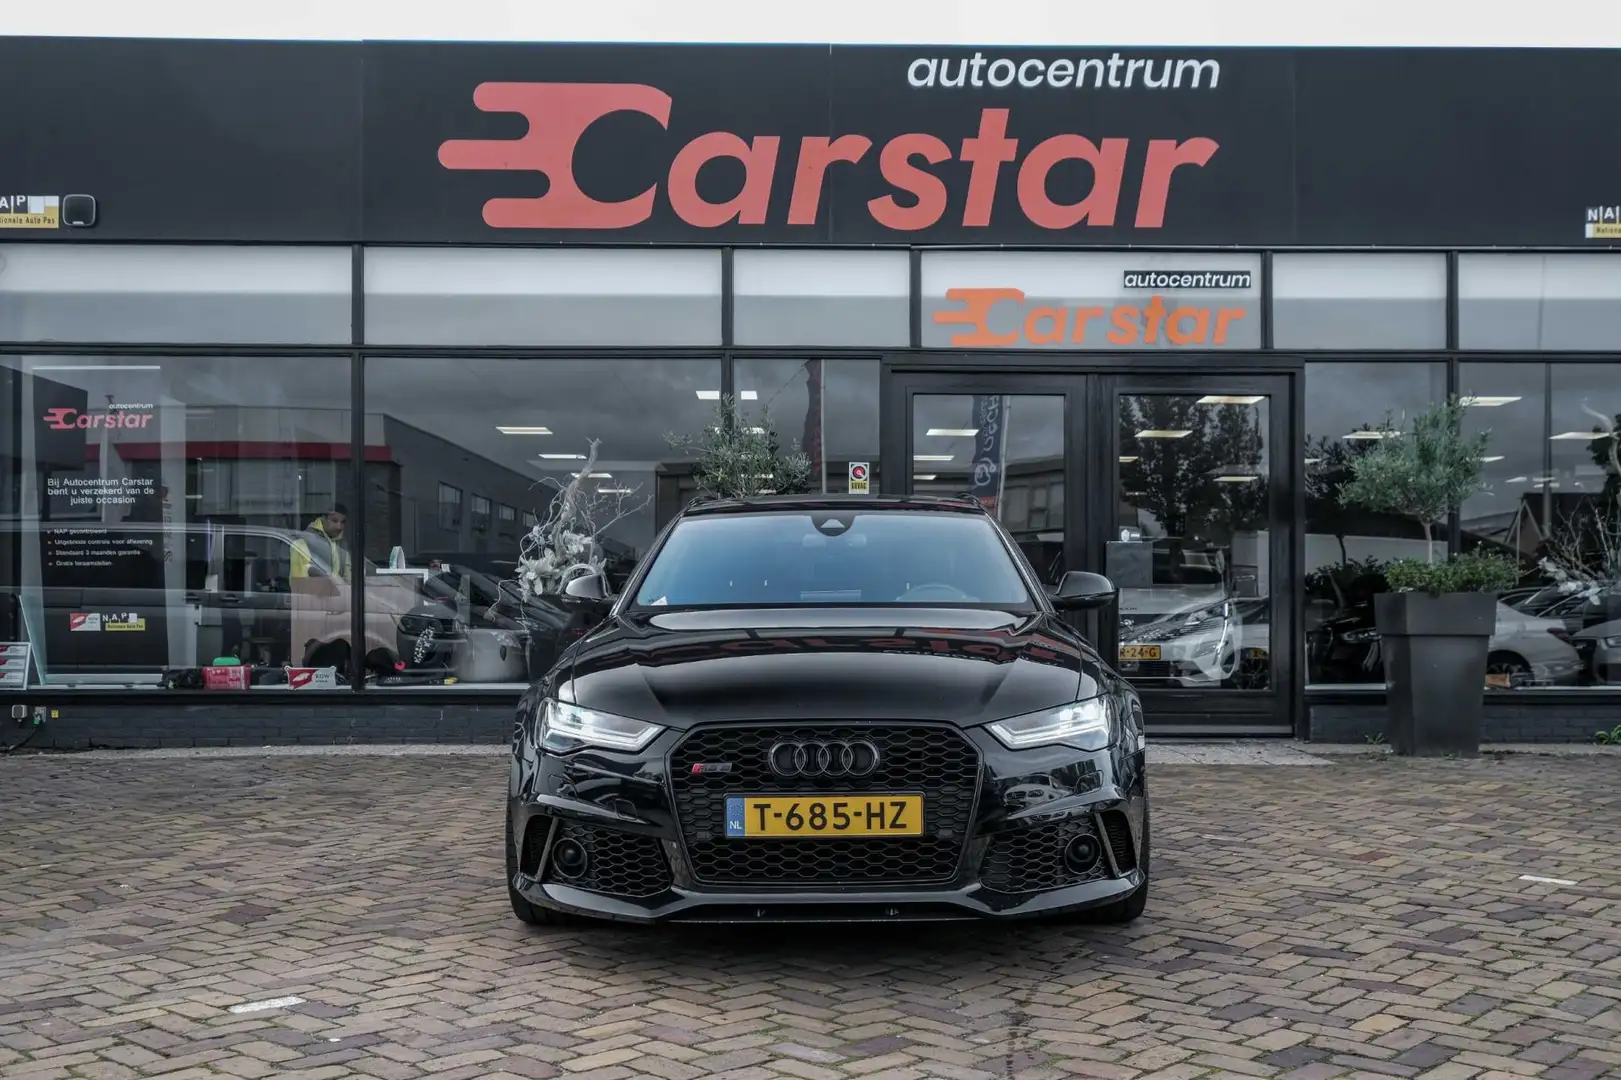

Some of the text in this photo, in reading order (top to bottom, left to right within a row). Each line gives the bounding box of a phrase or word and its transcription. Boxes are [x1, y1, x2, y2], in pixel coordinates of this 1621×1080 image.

[907, 52, 1221, 90] autocentrum
[438, 81, 1219, 231] Carstar
[26, 216, 41, 224] Auto
[43, 216, 55, 224] Pas
[1124, 271, 1251, 288] autocentrum
[932, 287, 1247, 347] Carstar
[108, 402, 154, 410] autocentrum
[43, 407, 153, 430] Carstar
[47, 477, 154, 488] Bij Autocentrum Carstar
[47, 487, 68, 495] bent
[80, 486, 122, 495] verzekerd
[143, 486, 154, 495] de
[70, 496, 136, 506] juiste occasion
[753, 801, 908, 831] T-685-HZ
[729, 820, 743, 830] NL
